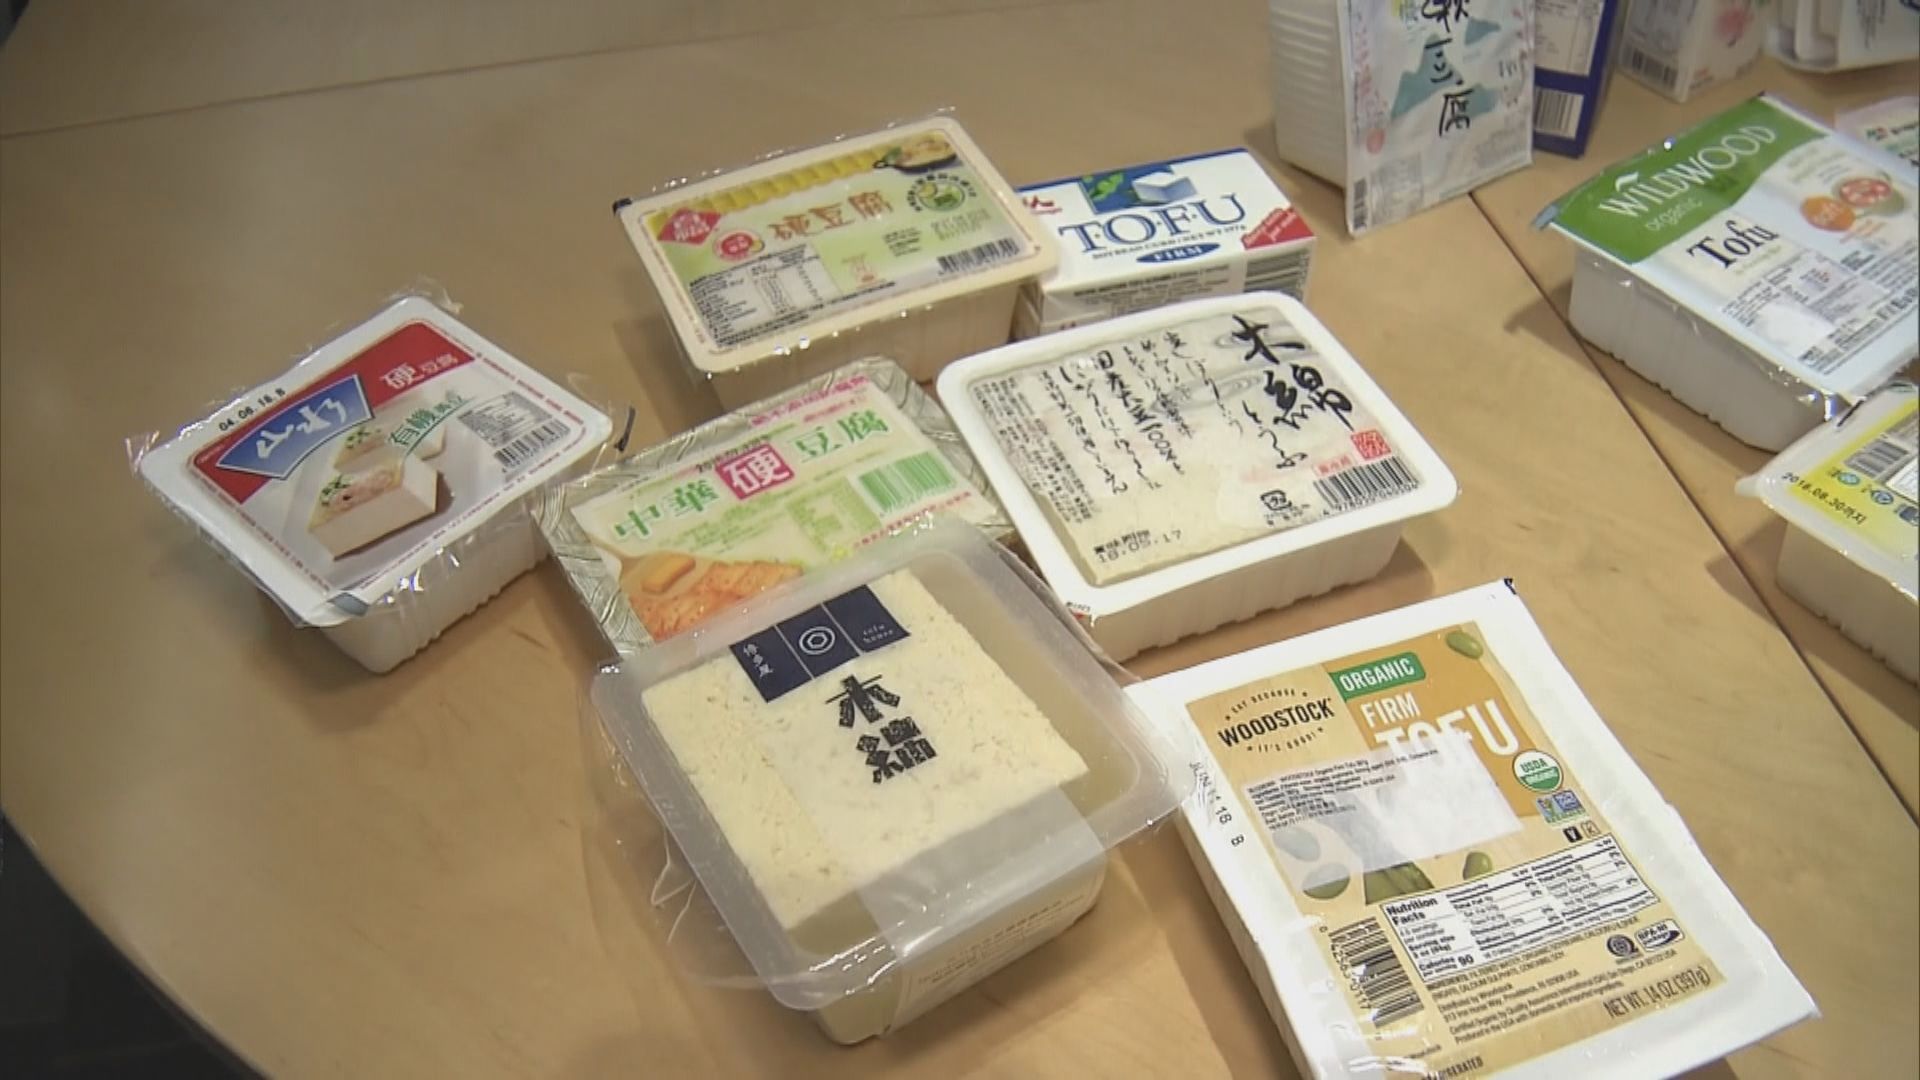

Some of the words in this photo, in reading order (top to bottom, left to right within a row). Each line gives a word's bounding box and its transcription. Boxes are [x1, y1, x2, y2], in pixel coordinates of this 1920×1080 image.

[1598, 125, 1777, 218] WILDWOOD
[1154, 246, 1203, 260] FIRM
[1687, 220, 1780, 269] Tofu
[1231, 314, 1355, 432] 木綿
[1241, 398, 1308, 470] とうふ
[1339, 657, 1415, 692] ORGANIC
[1251, 688, 1296, 704] BECAUSE
[1360, 691, 1421, 728] FIRM
[825, 674, 937, 784] 木綿
[1218, 697, 1335, 748] WOODSTOCK
[1375, 699, 1520, 757] TOFU
[1520, 757, 1549, 772] USDA
[1386, 896, 1439, 917] Nutrition
[1393, 911, 1426, 927] Facts
[1409, 938, 1438, 952] Serving
[1440, 934, 1456, 943] size
[1419, 956, 1456, 971] Calories
[1458, 954, 1475, 968] 90
[1602, 997, 1629, 1020] NET
[1623, 990, 1650, 1010] WT.
[1643, 984, 1664, 1004] 14
[1657, 979, 1679, 999] OZ
[1674, 965, 1712, 993] (397g)
